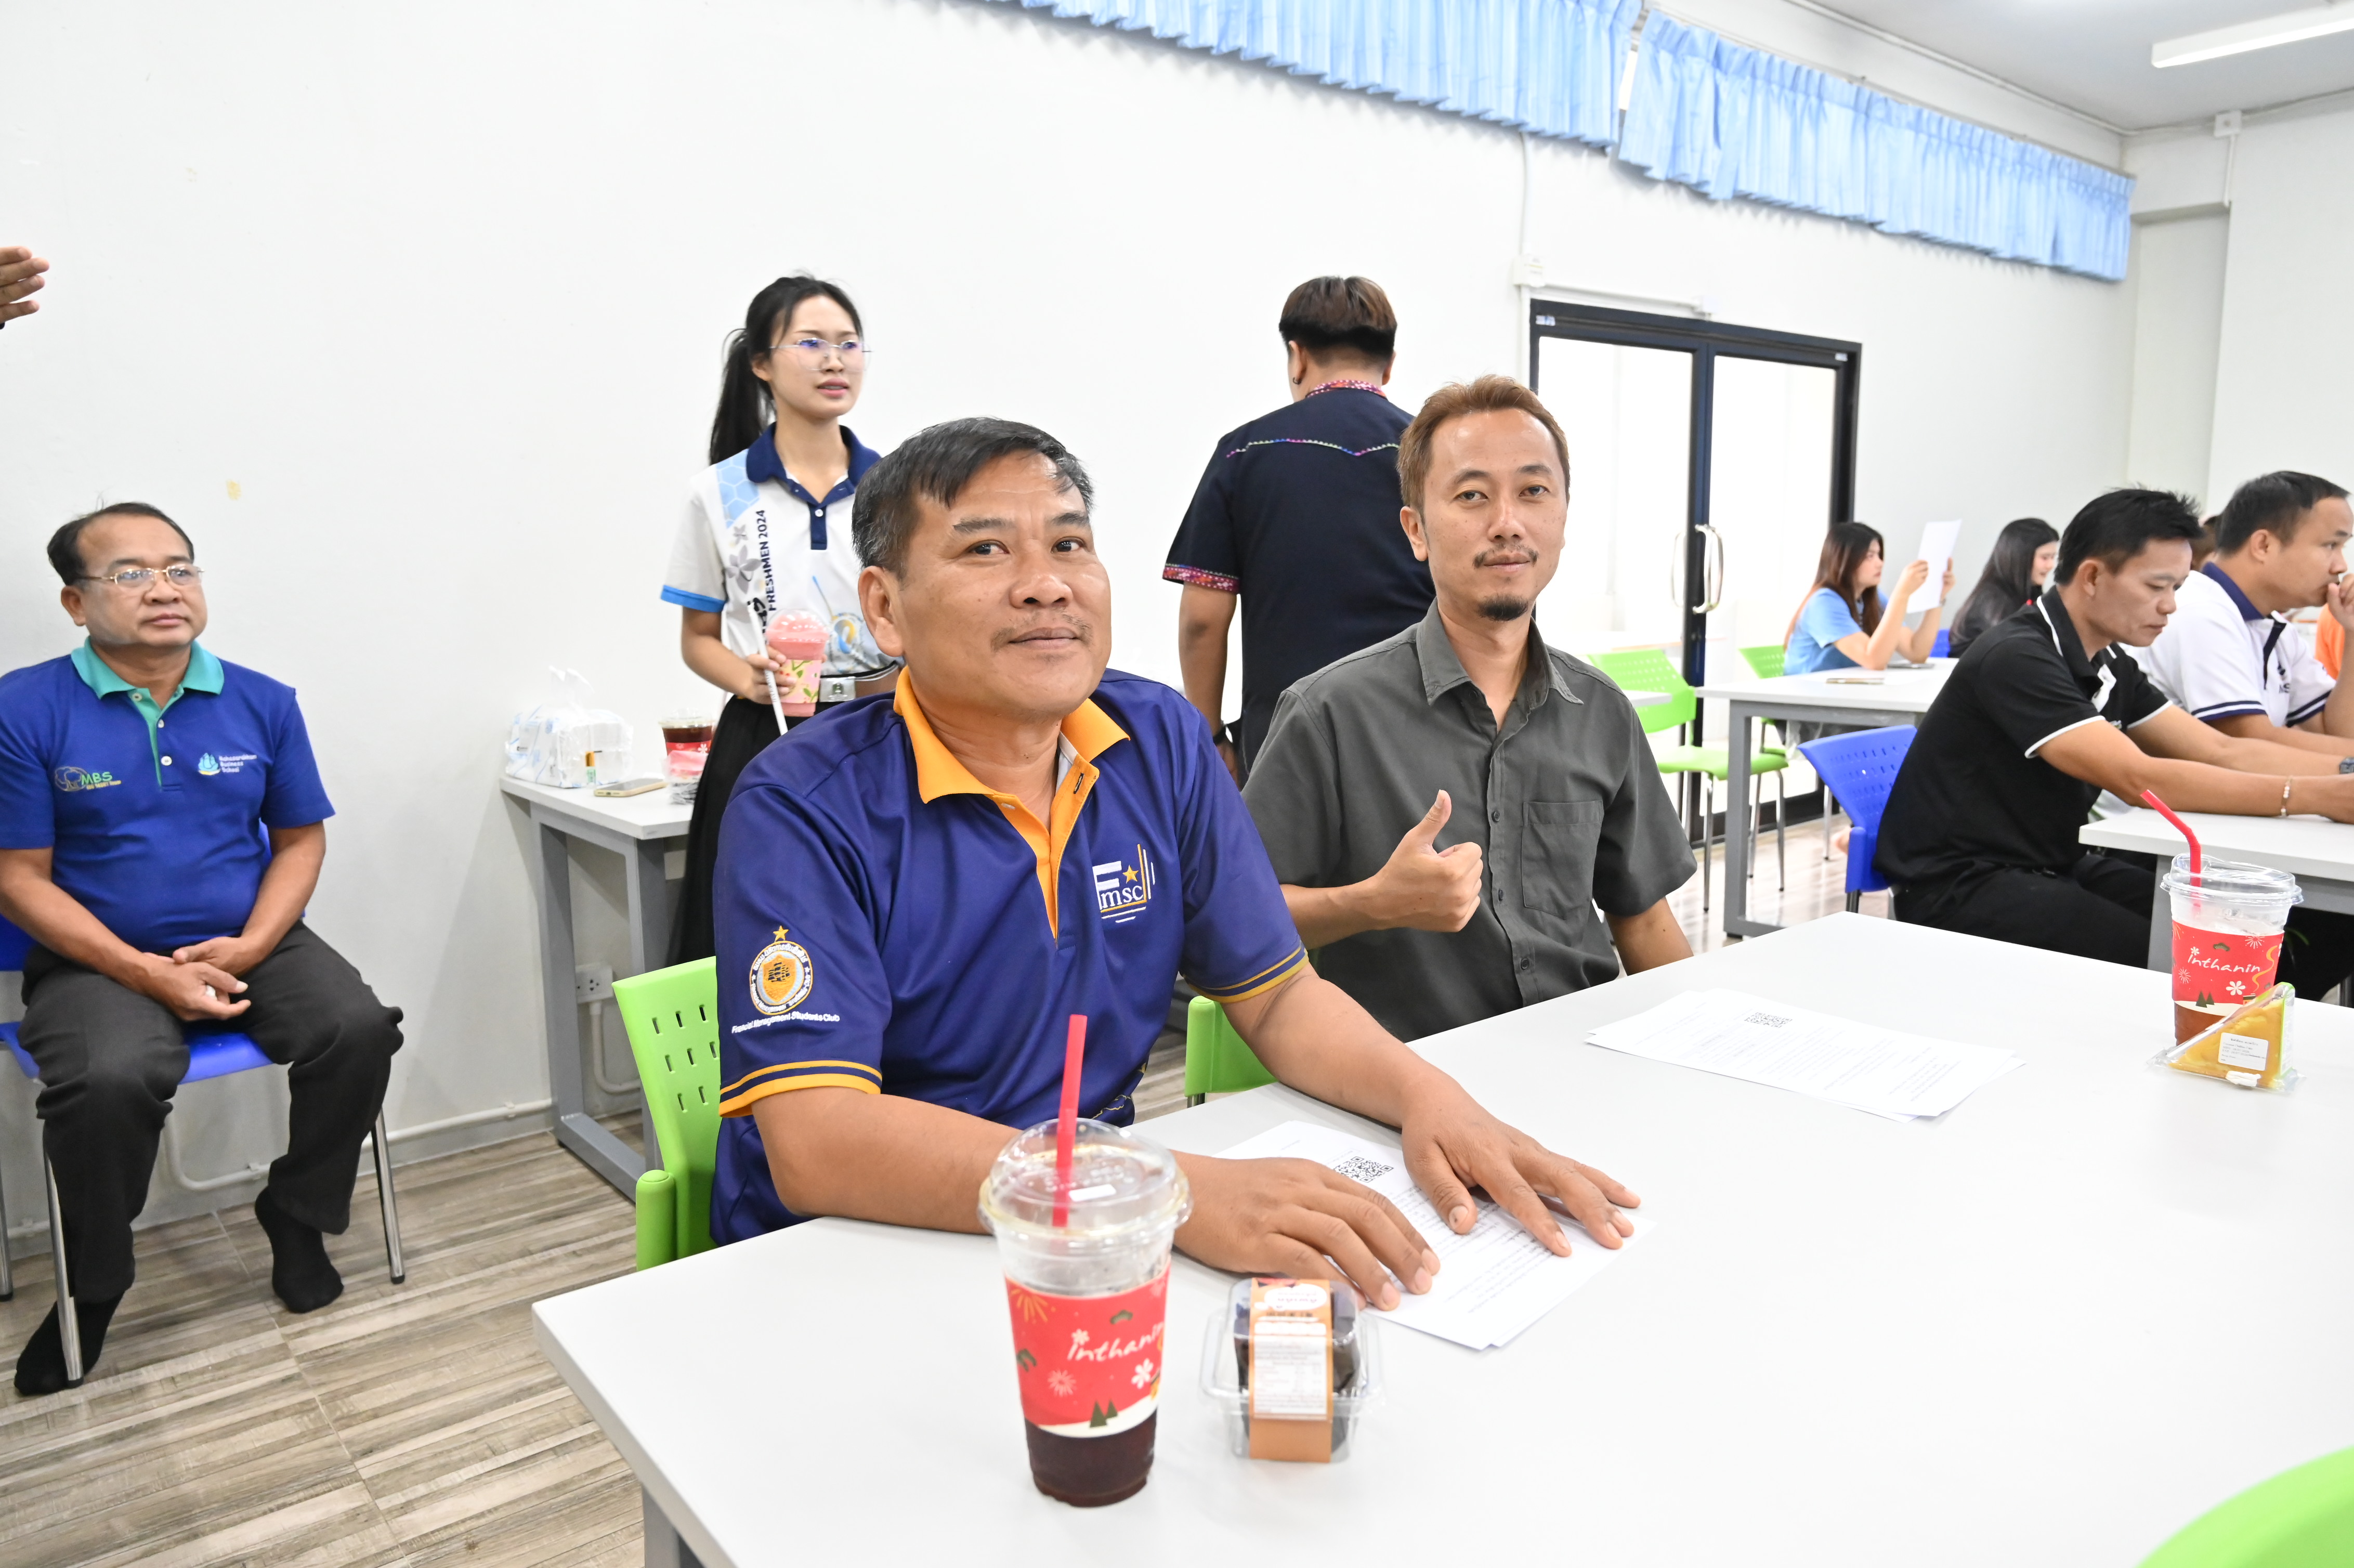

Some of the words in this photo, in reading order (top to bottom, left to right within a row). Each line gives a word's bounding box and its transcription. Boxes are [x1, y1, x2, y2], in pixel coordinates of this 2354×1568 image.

[755, 510, 768, 539] 2024
[759, 541, 776, 611] FRESHMEN
[82, 772, 112, 785] MBS
[2188, 946, 2260, 973] inthanin
[823, 1013, 840, 1022] Club
